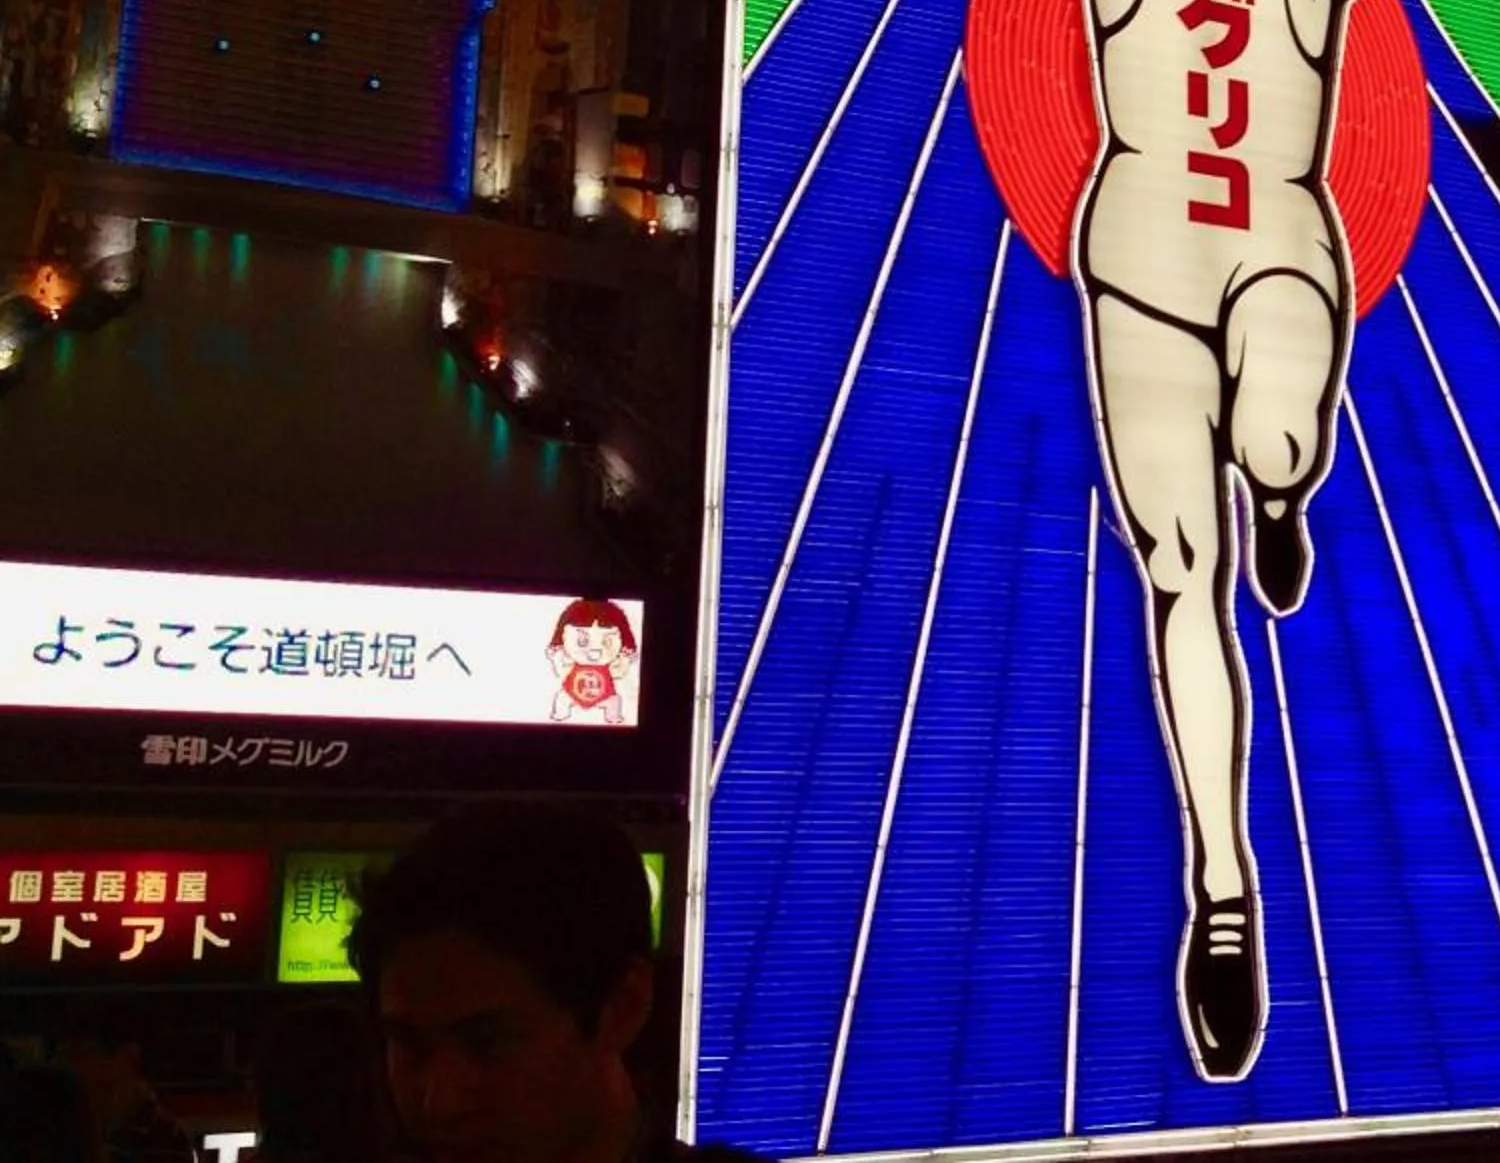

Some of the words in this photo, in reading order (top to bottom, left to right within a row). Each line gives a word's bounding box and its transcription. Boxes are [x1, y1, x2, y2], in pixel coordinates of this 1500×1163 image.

[32, 615, 472, 681] ようこそ道頓堀へ
[141, 734, 349, 768] 雪印メグミルク
[9, 870, 208, 903] 個室居酒屋
